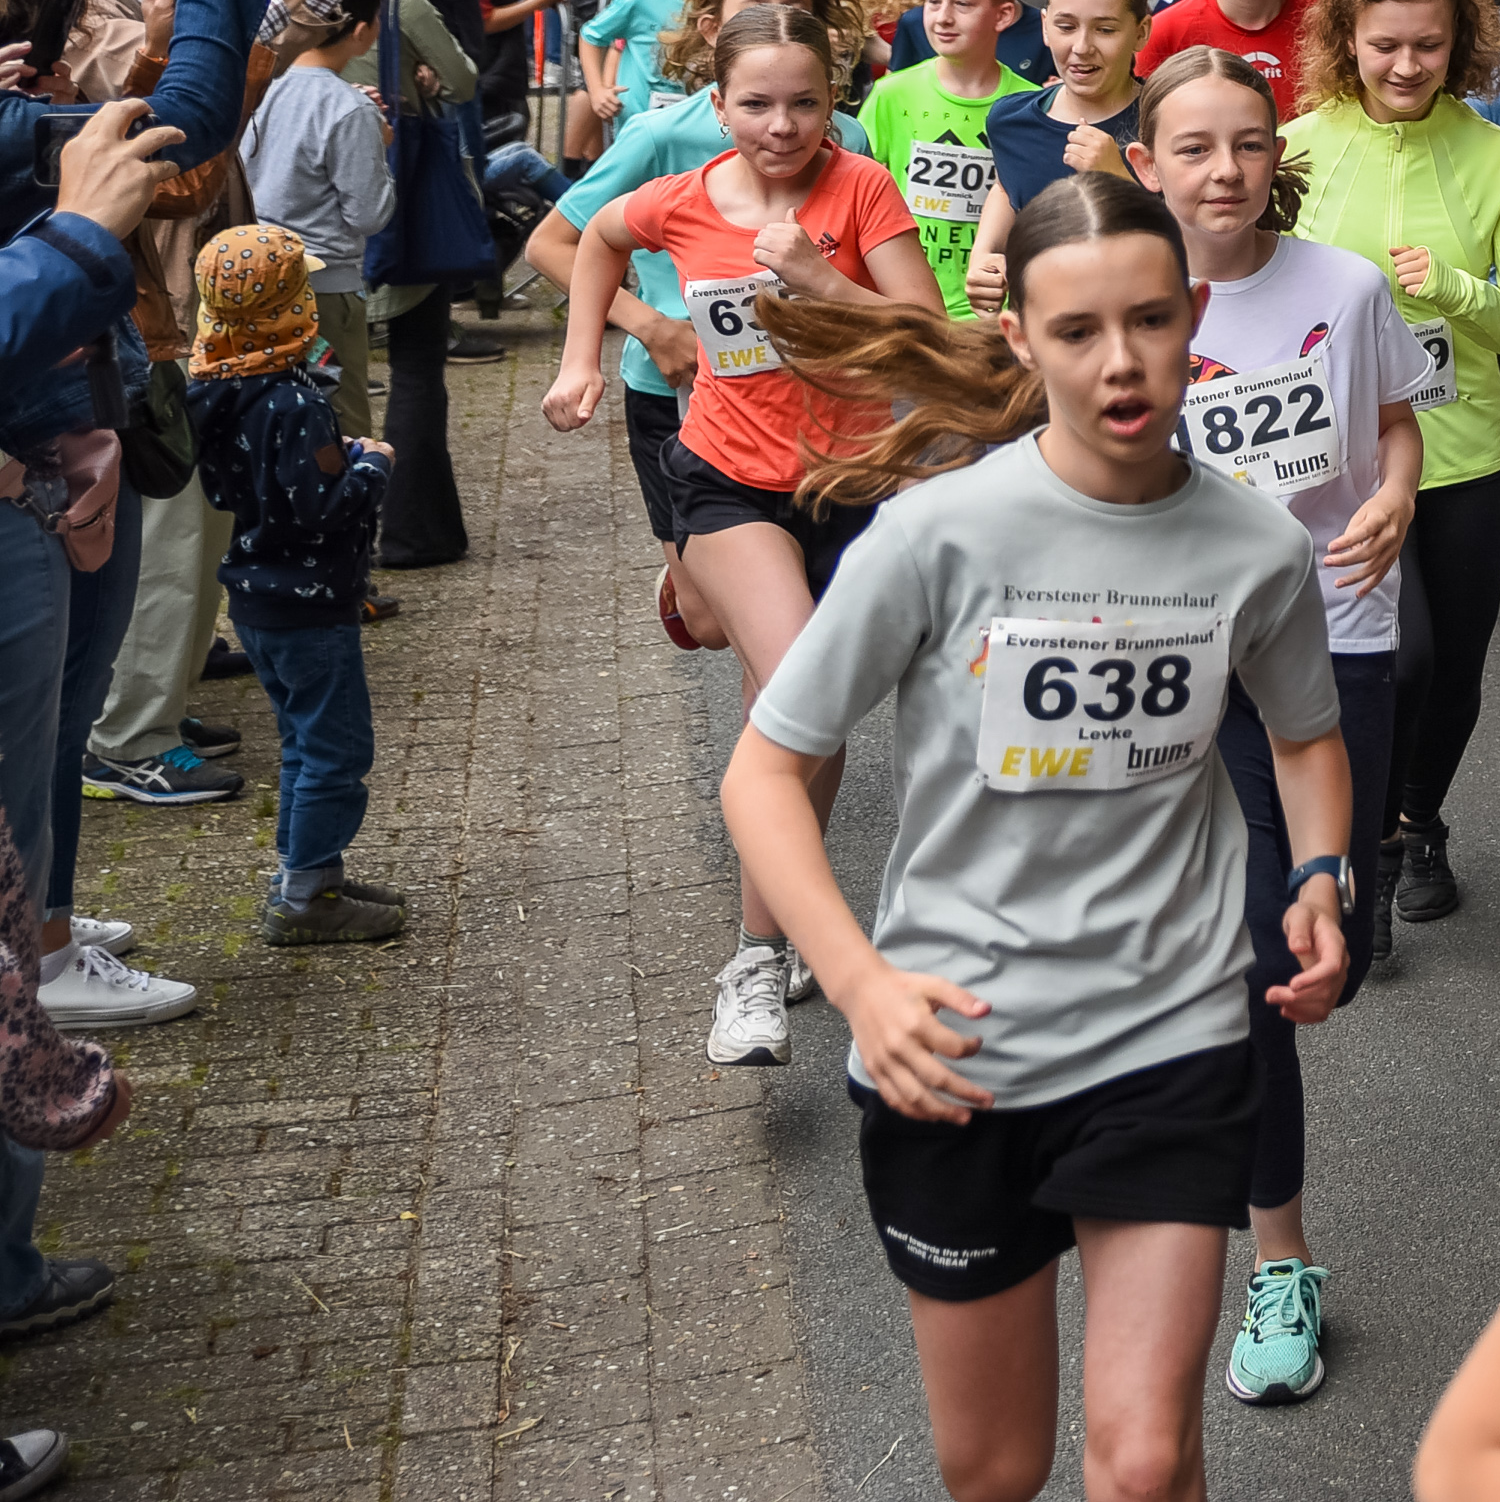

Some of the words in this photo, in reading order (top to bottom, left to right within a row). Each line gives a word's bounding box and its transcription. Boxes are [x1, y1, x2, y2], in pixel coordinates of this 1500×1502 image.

[913, 195, 952, 214] EWE
[940, 190, 974, 200] Yannick
[692, 286, 745, 298] Everstener
[749, 278, 783, 291] Bunn
[717, 345, 768, 369] EWE
[1233, 367, 1313, 396] Brunnenlauf
[1410, 384, 1446, 403] runs
[1233, 450, 1271, 466] Clara
[1273, 452, 1330, 481] bruns
[1003, 584, 1102, 605] Everstener
[1106, 588, 1220, 609] Brunnenlauf
[1006, 633, 1109, 651] Everstener
[1114, 629, 1215, 651] Brunnenlauf
[1023, 654, 1192, 722] 638
[1078, 727, 1133, 741] Levke
[1000, 745, 1095, 778] EWE
[1126, 741, 1195, 770] bruns
[933, 1255, 969, 1268] DREAM
[942, 1247, 960, 1258] the
